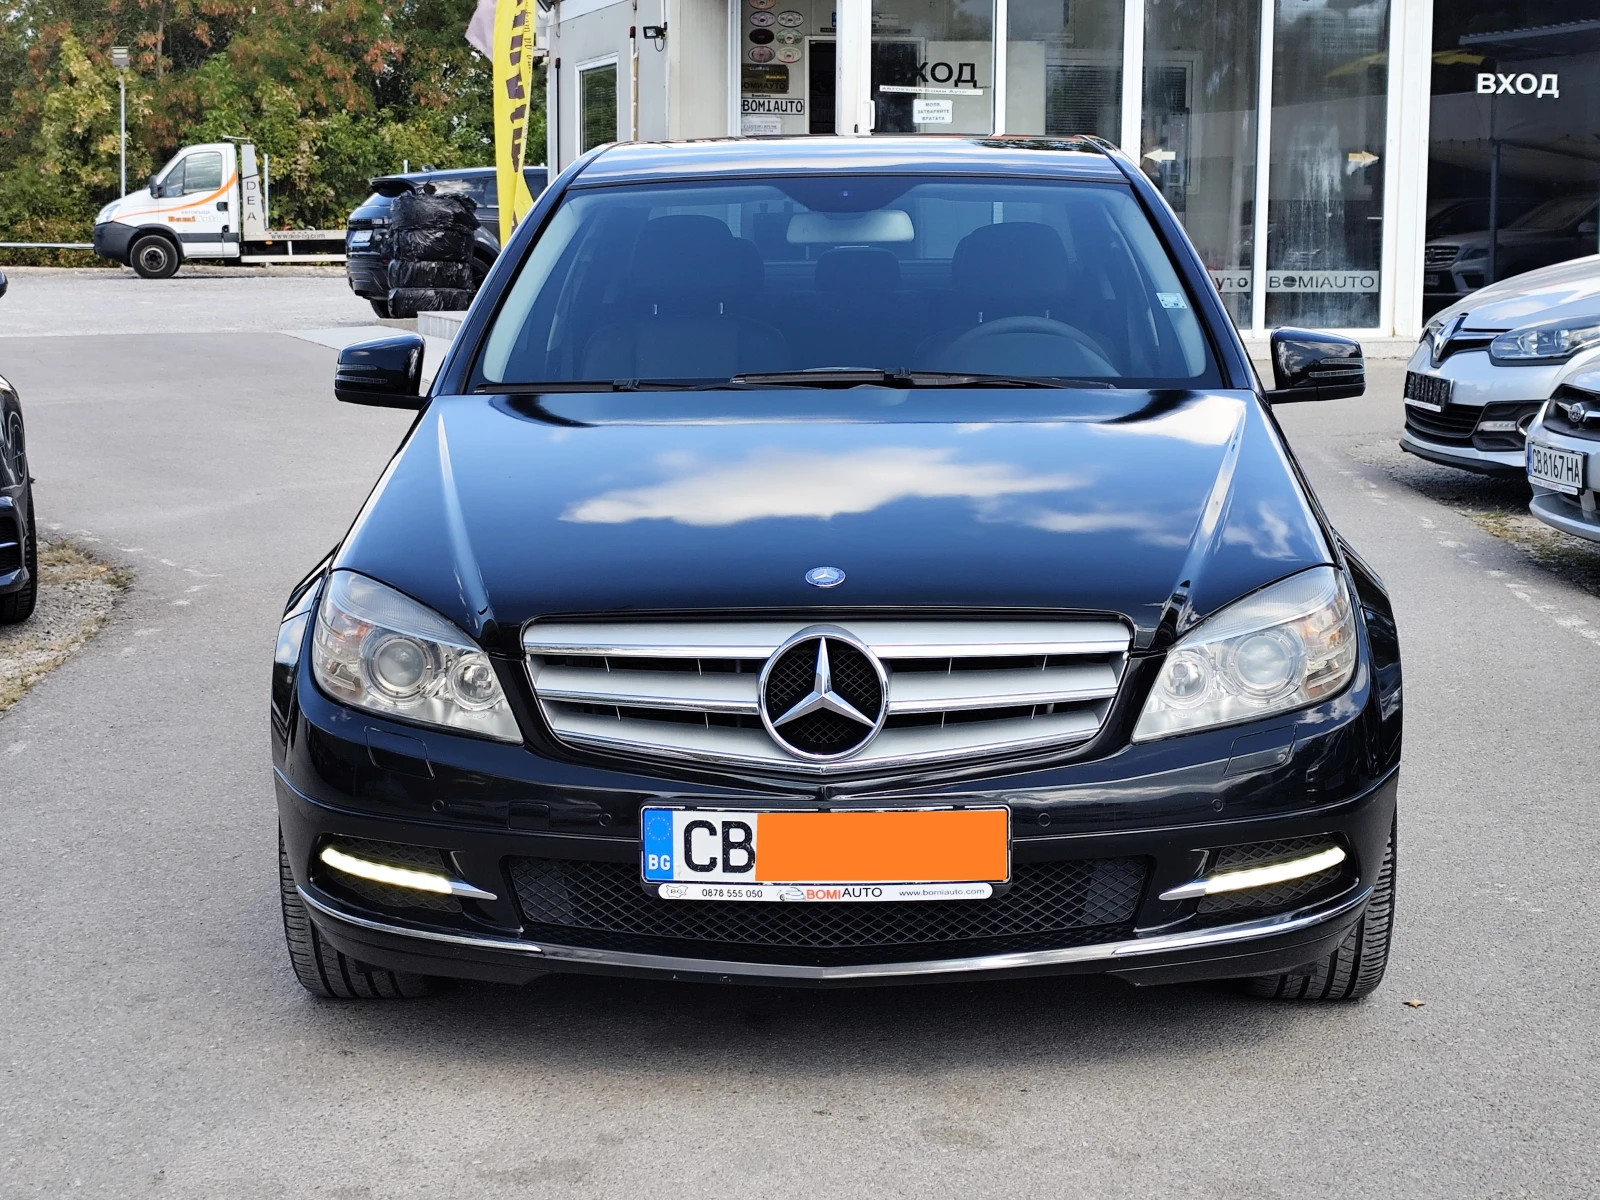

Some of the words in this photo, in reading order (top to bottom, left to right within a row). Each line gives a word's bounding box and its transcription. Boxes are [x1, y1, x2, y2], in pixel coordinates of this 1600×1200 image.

[911, 62, 977, 87] ХОД
[1476, 73, 1559, 98] ВХОД
[742, 99, 804, 113] BOMIAUTO
[648, 854, 671, 871] BG
[701, 888, 724, 897] 0878
[726, 889, 743, 898] 555
[745, 889, 763, 898] 050
